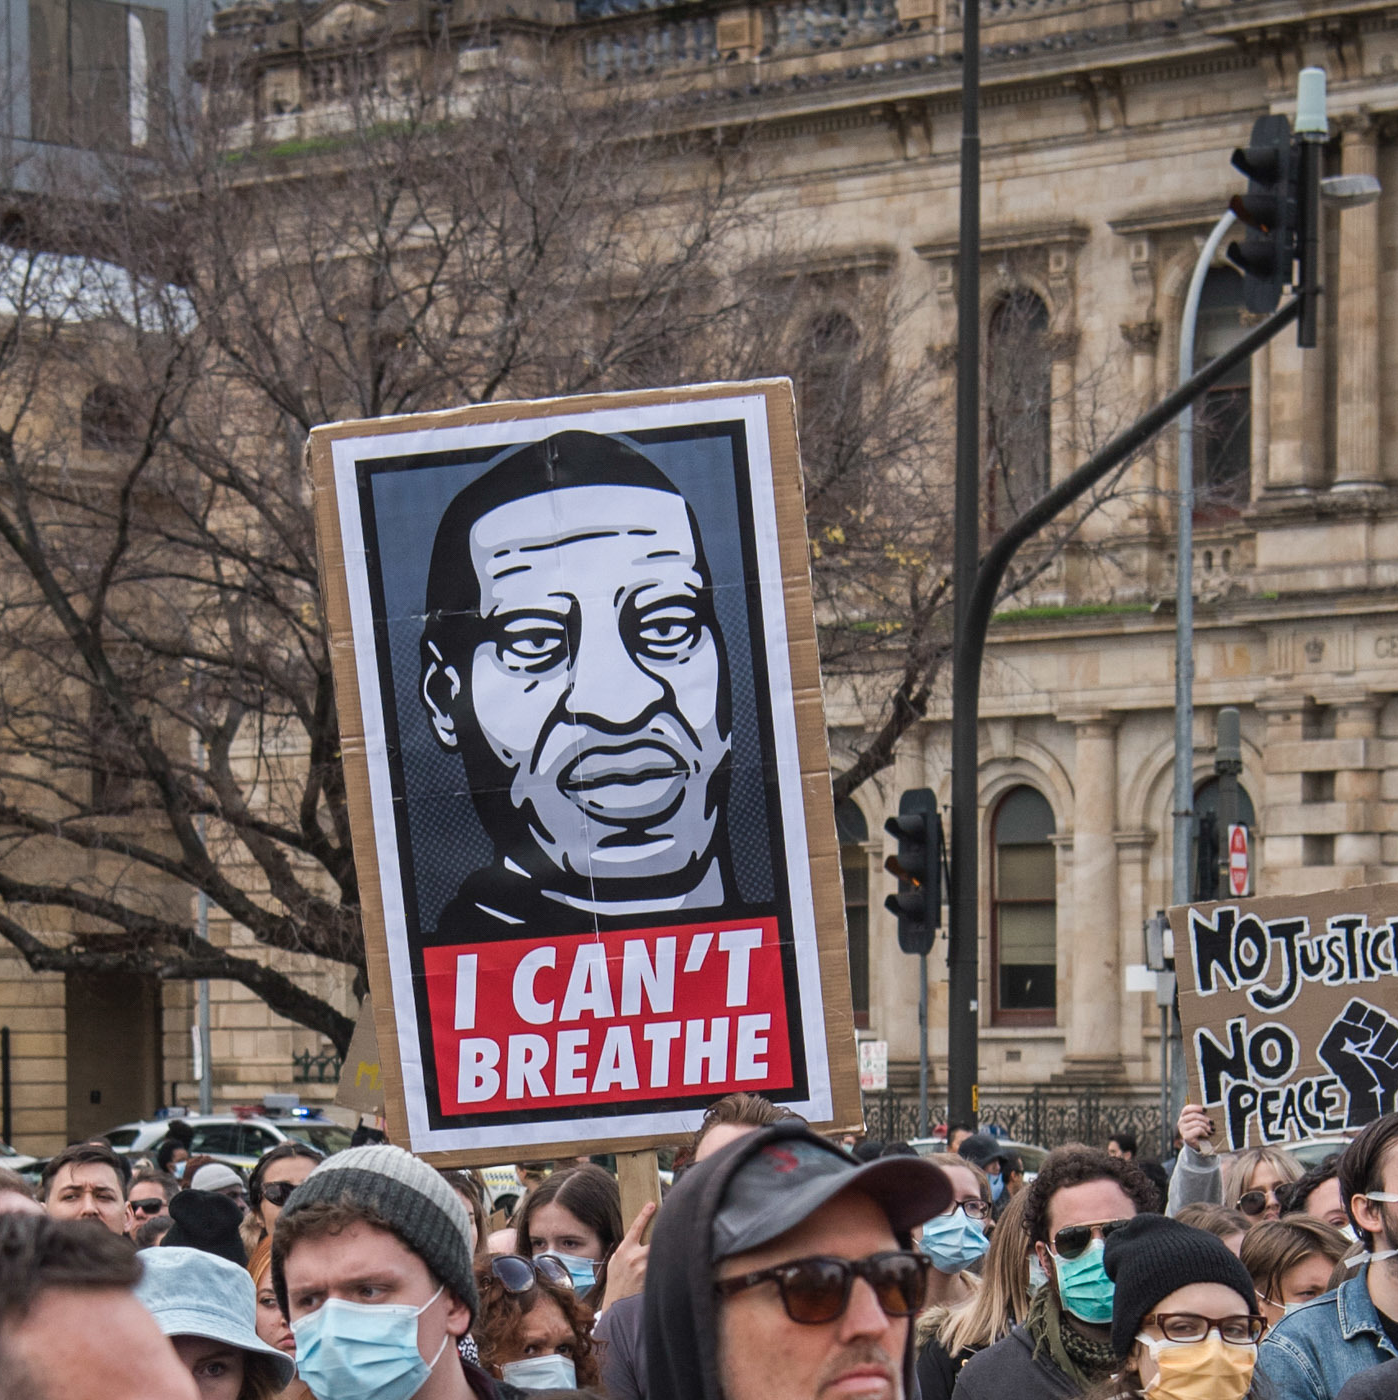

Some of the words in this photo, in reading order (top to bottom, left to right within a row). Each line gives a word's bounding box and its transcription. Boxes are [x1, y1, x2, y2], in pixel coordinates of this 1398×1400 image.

[454, 953, 479, 1031] I
[511, 927, 764, 1025] CAN'T
[1188, 905, 1269, 996] NO
[456, 1013, 772, 1105] BREATHE
[1194, 1015, 1299, 1107] NO
[1223, 1074, 1354, 1153] PEACE
